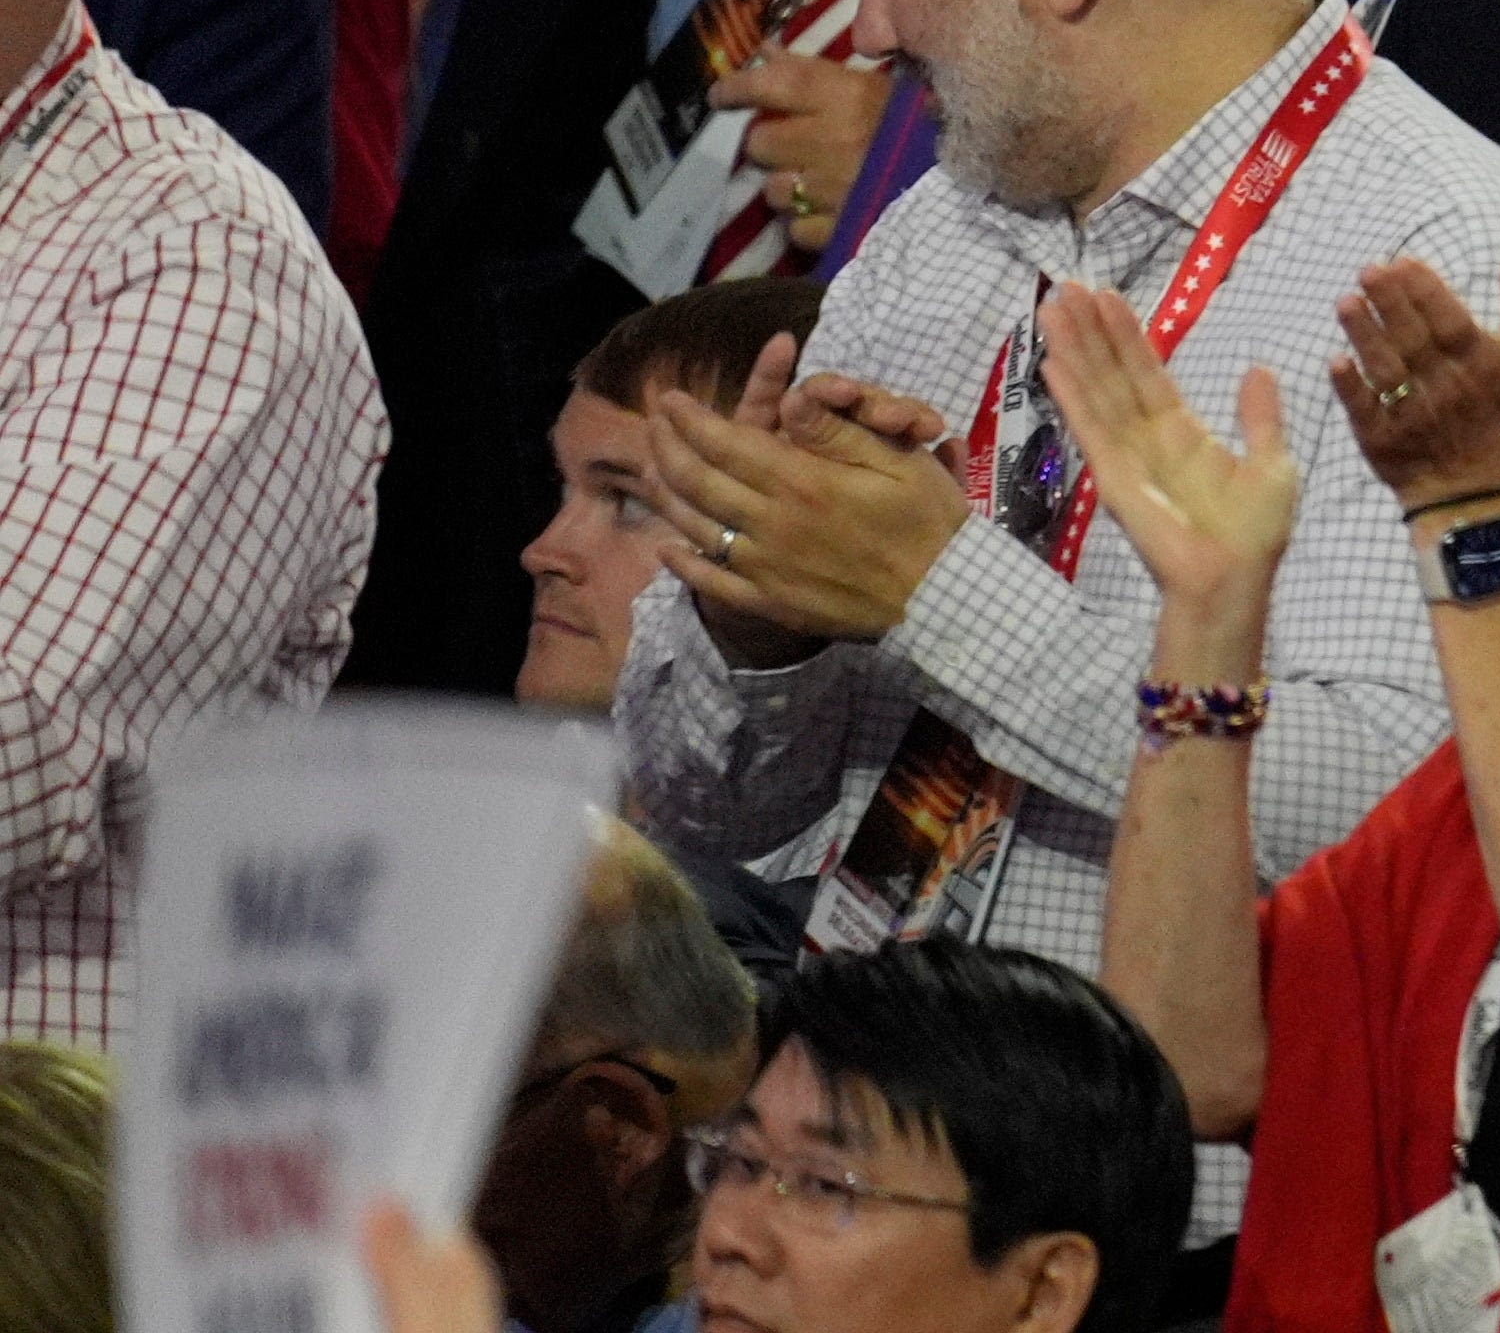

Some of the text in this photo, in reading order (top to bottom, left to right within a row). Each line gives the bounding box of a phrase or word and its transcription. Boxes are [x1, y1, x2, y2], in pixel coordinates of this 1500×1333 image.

[1229, 154, 1264, 207] TRUST
[1249, 159, 1282, 203] DATA
[1003, 381, 1025, 413] KCB
